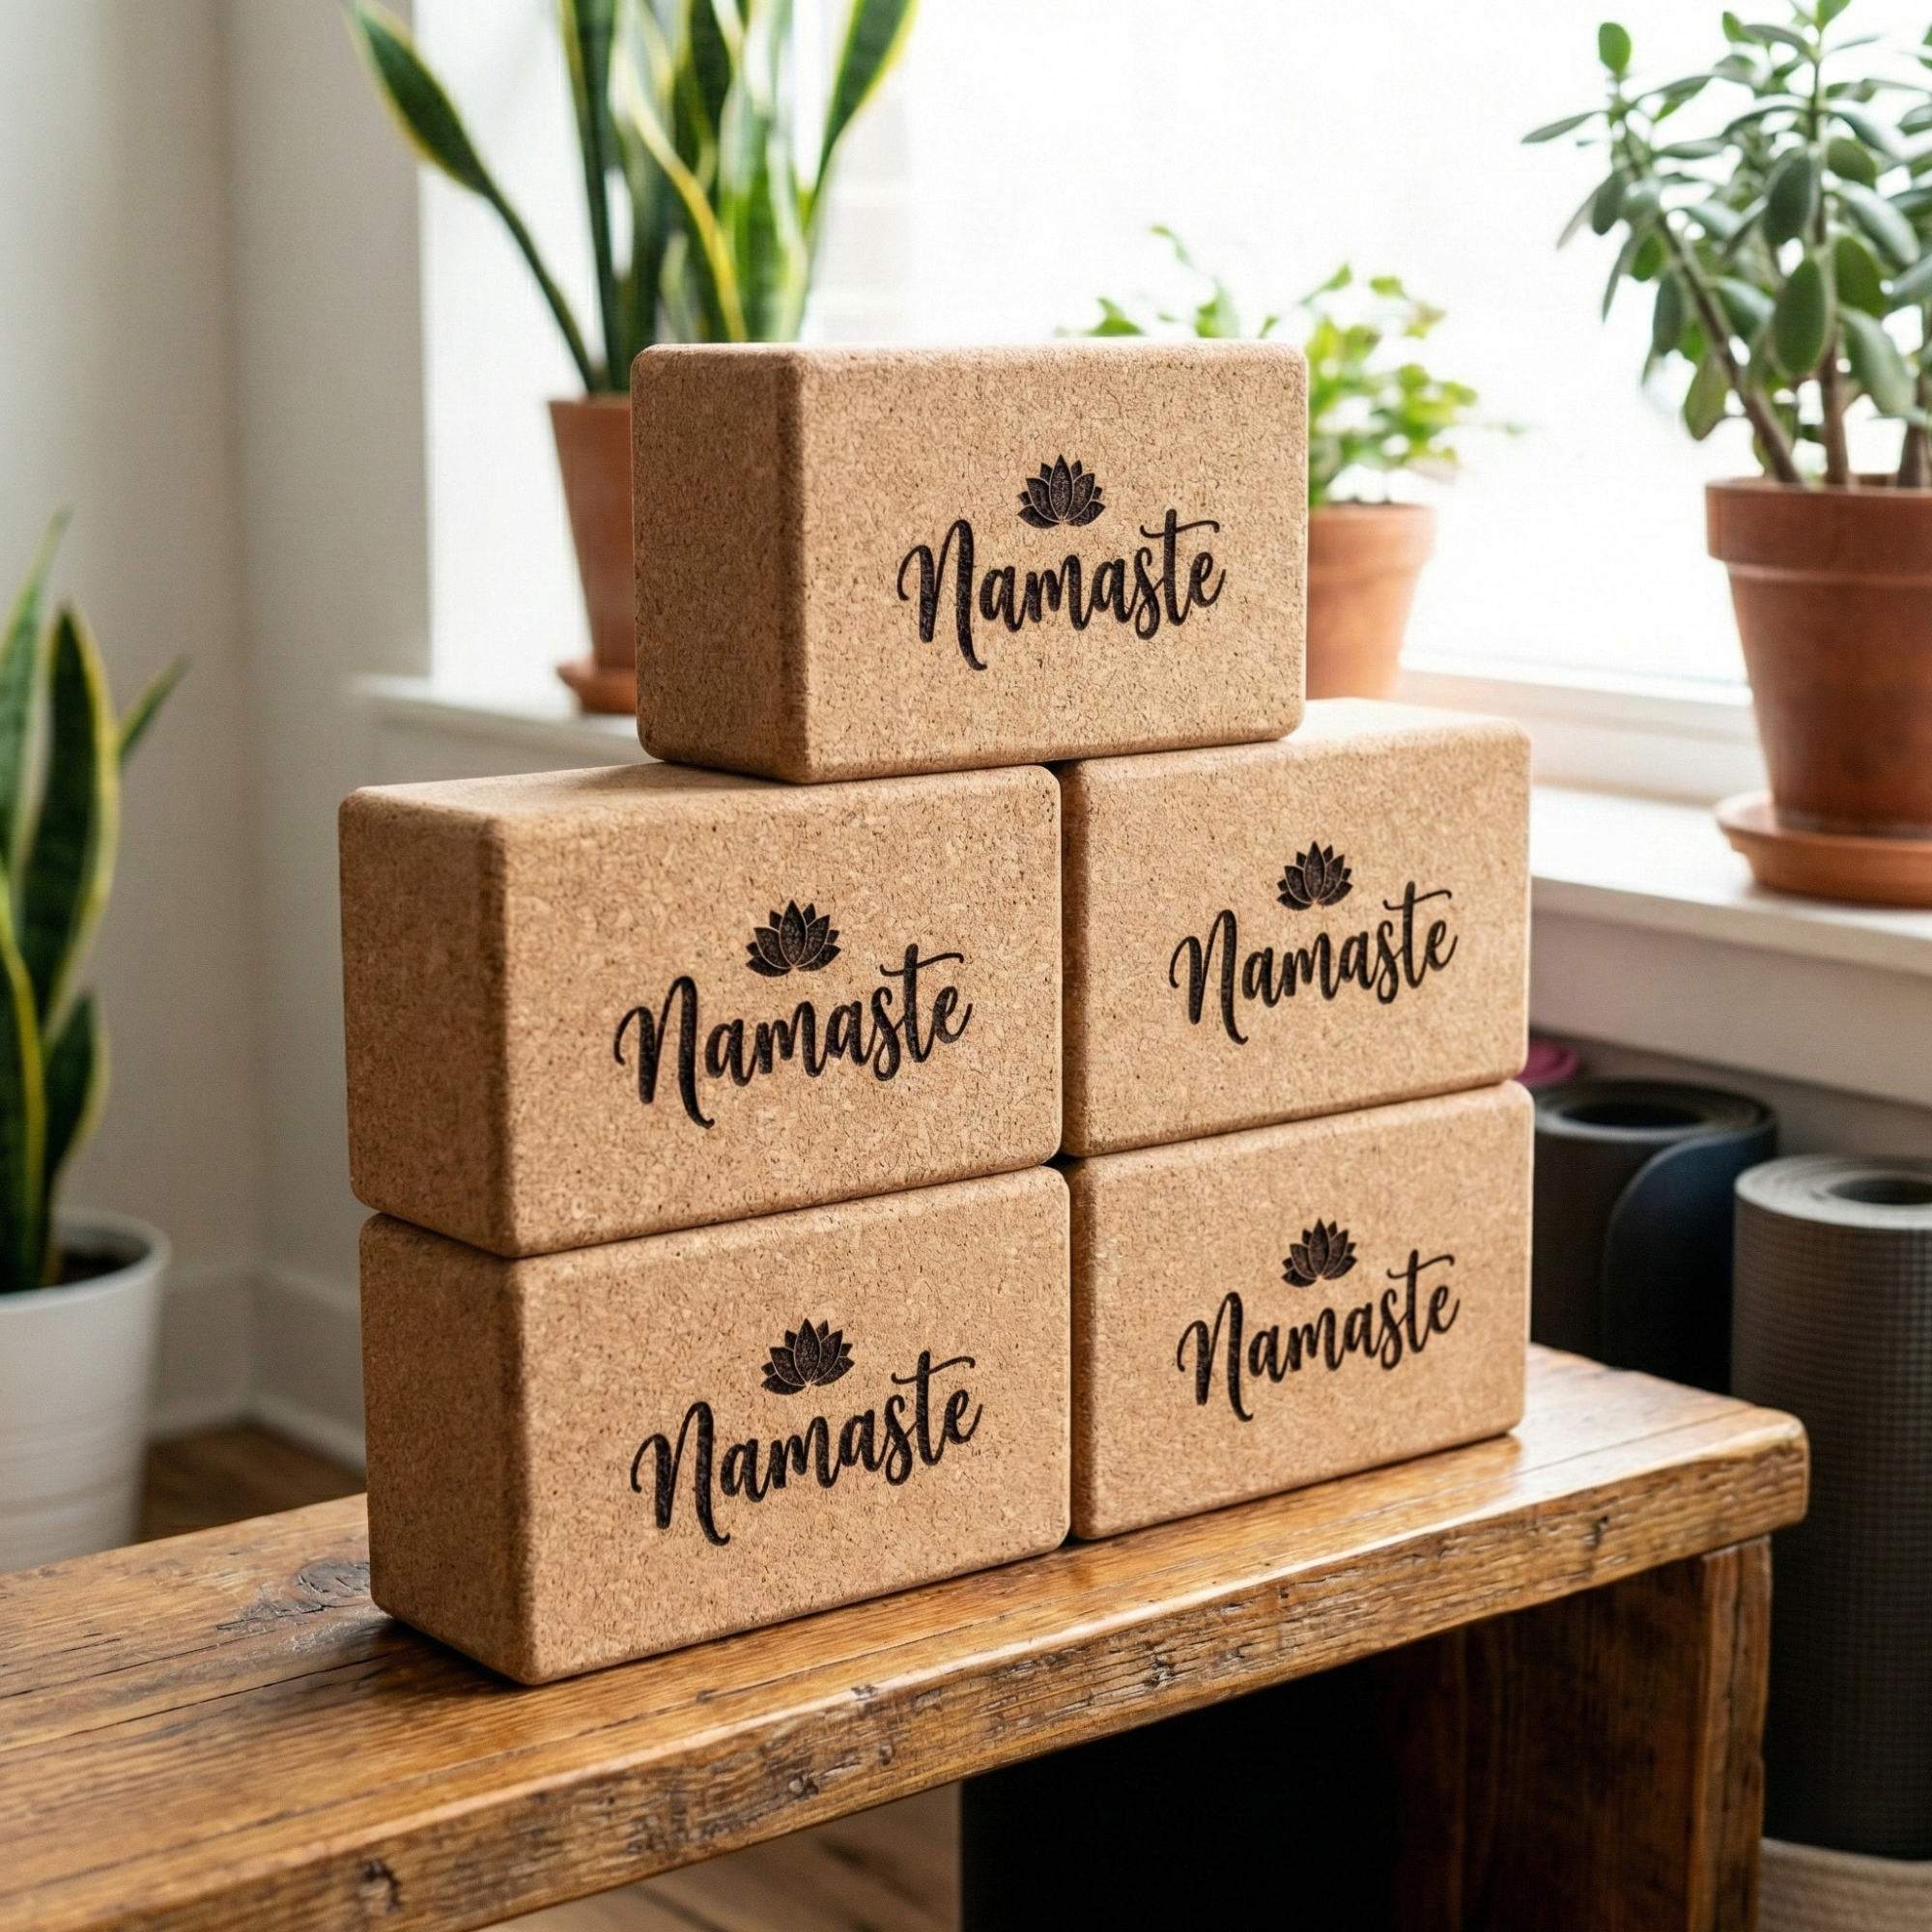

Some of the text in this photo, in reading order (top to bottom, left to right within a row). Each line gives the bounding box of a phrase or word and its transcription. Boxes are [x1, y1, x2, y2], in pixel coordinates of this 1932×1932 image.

[896, 508, 1226, 671] Namaste
[612, 943, 973, 1130] Namaste
[1169, 881, 1458, 1045] Namaste
[1177, 1249, 1461, 1422] Namaste
[630, 1350, 983, 1547] Namaste
